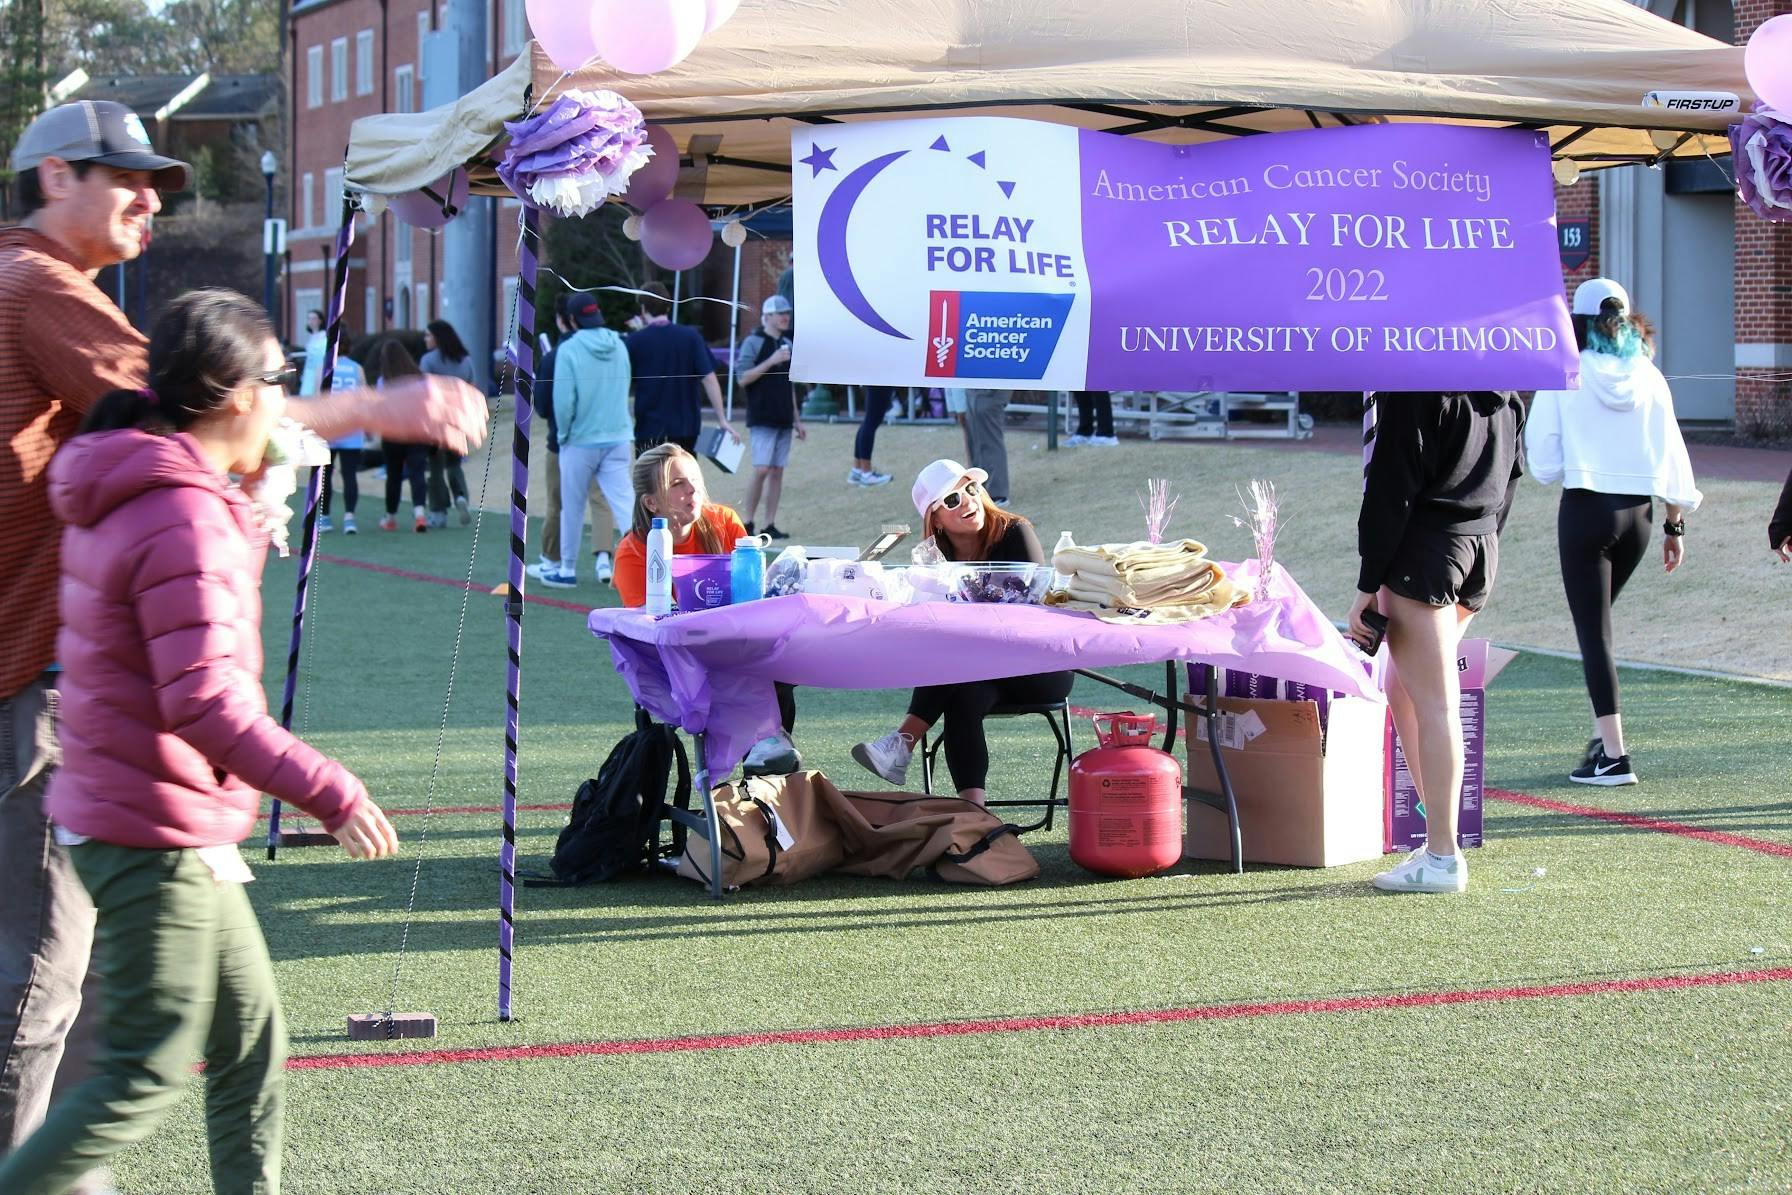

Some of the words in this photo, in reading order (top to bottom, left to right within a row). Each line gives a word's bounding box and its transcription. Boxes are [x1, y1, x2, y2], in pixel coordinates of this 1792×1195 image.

[1091, 168, 1250, 202] American
[1263, 163, 1383, 190] Cancer
[1392, 159, 1491, 202] Society
[926, 214, 1035, 243] RELAY
[1163, 213, 1317, 248] RELAY
[1331, 213, 1411, 249] FOR
[1423, 217, 1515, 250] LIFE
[1563, 227, 1581, 248] 153
[927, 246, 997, 273] FOR
[1008, 249, 1075, 278] LIFE
[1305, 267, 1389, 302] 2022
[965, 313, 1053, 330] American
[964, 328, 1028, 345] Cancer
[1119, 327, 1321, 354] UNIVERSITY
[1331, 327, 1373, 353] OF
[1383, 327, 1557, 353] RICHMOND
[963, 344, 1031, 363] Society
[1249, 672, 1260, 699] PAIN
